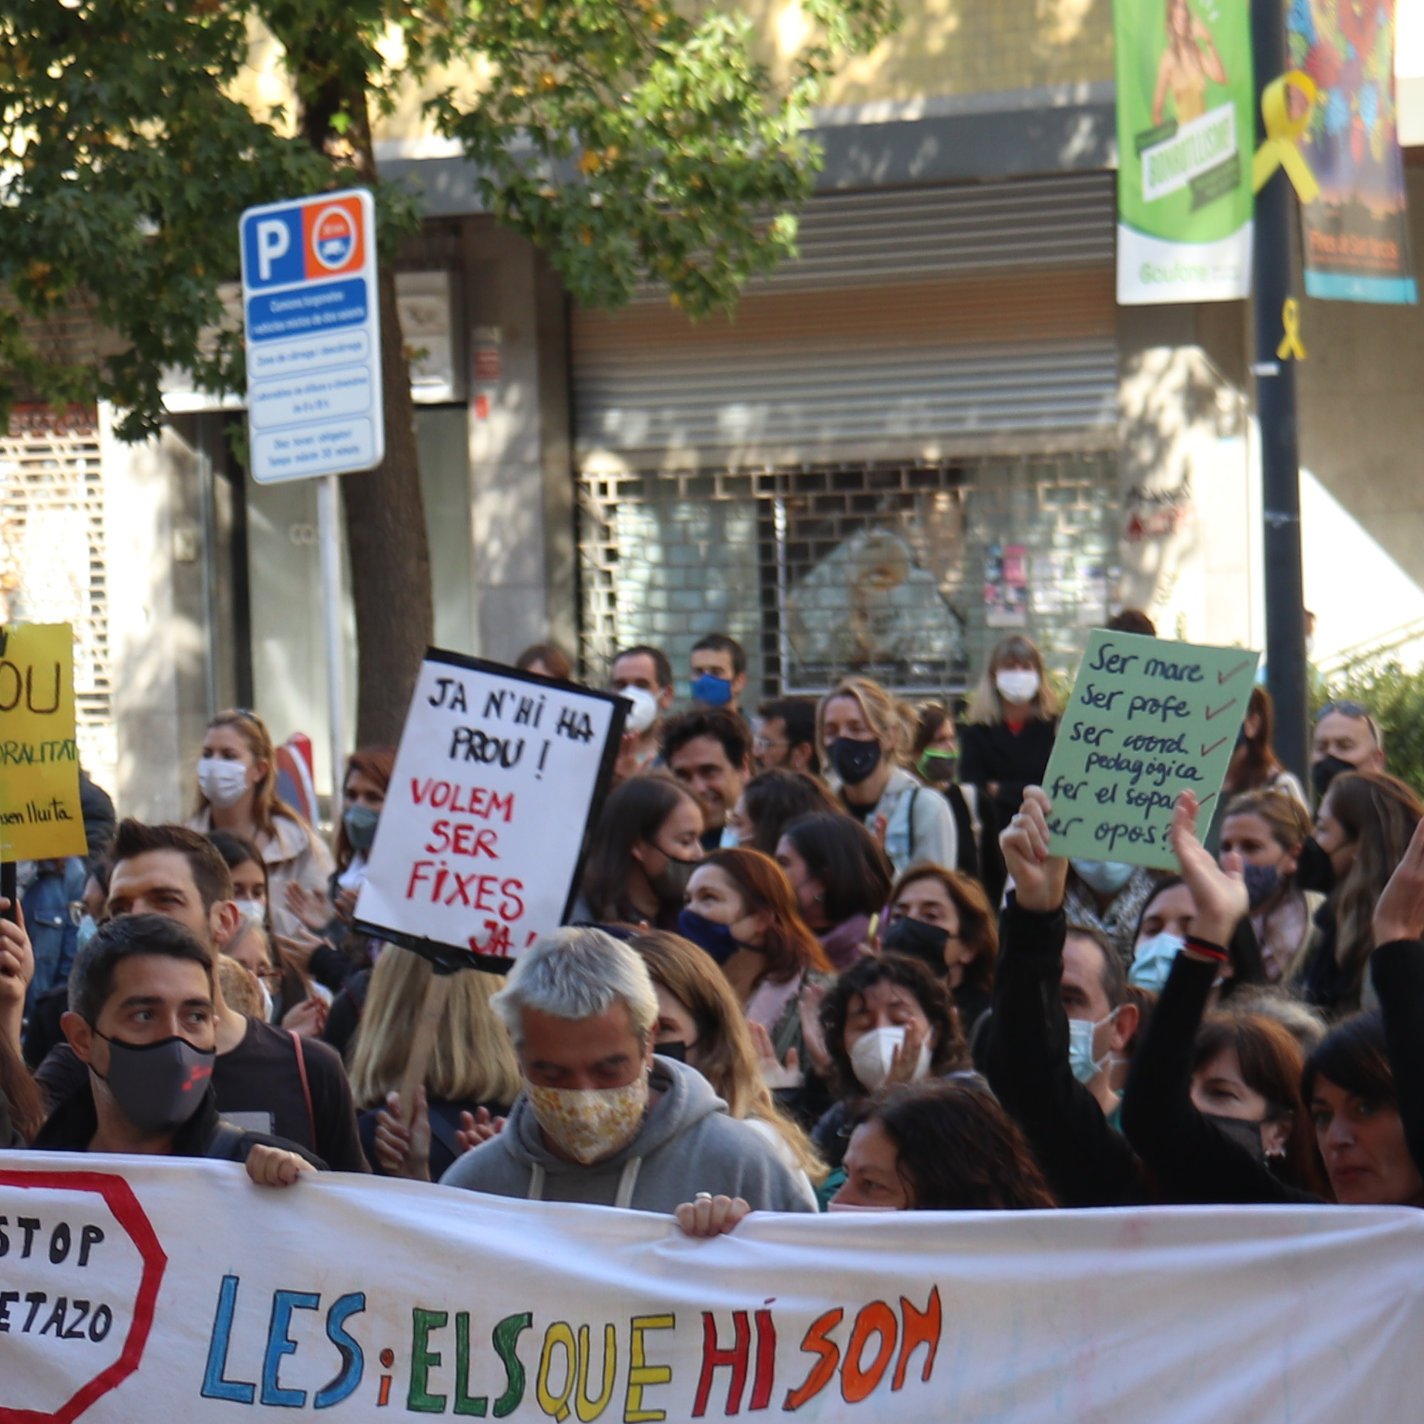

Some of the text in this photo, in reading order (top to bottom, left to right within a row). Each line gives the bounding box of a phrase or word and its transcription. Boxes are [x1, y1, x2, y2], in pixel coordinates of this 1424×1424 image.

[257, 218, 290, 282] P
[1089, 642, 1205, 684] Ser mare
[428, 677, 468, 713] JA
[555, 704, 596, 744] HA
[1126, 694, 1191, 724] profe
[448, 725, 526, 769] PROU
[409, 776, 516, 824] VOLEM
[1051, 774, 1176, 821] fer el sopa
[424, 819, 502, 861] SER
[1046, 815, 1084, 839] er
[467, 919, 516, 958] JA
[200, 1274, 367, 1410] LES
[406, 1306, 534, 1419] ELS
[536, 1312, 676, 1424] QUE
